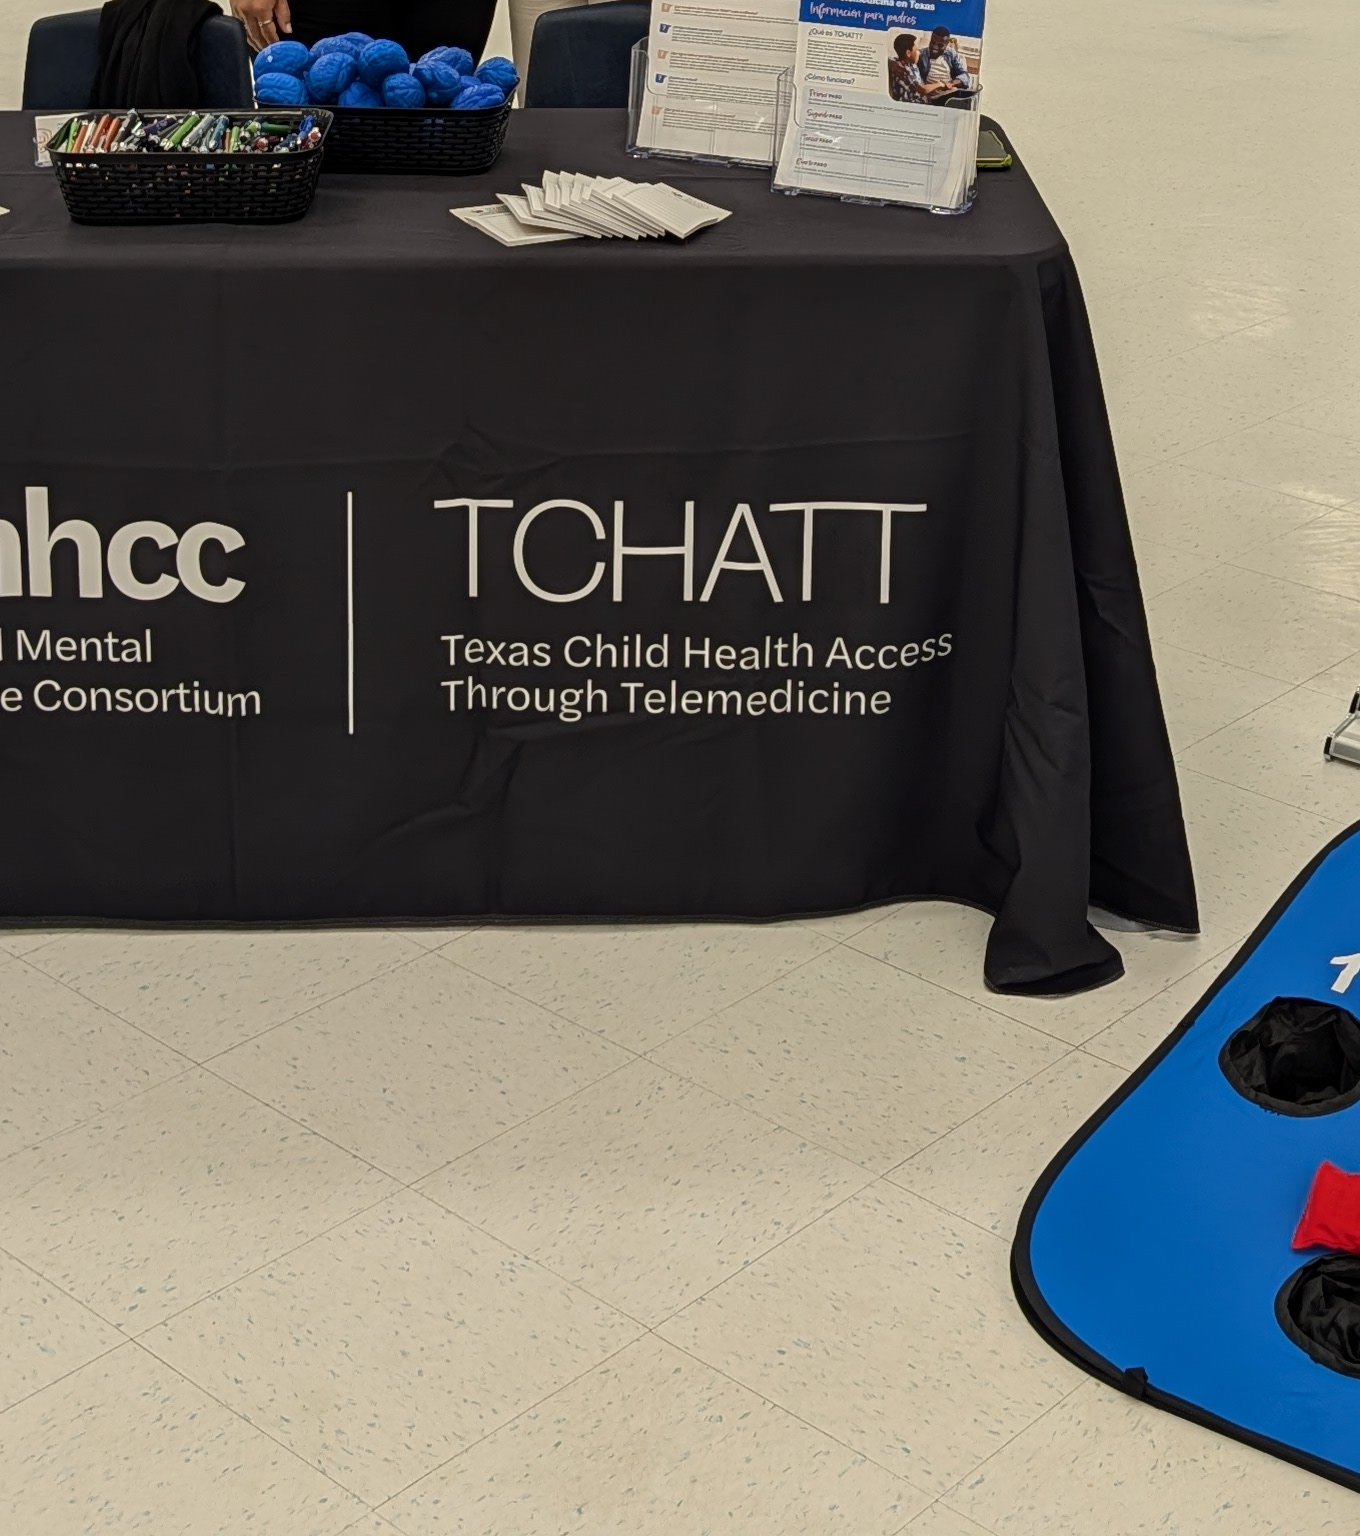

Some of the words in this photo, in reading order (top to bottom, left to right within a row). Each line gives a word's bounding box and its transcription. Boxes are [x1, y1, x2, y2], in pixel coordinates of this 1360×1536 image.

[810, 2, 862, 19] Información
[863, 11, 884, 24] para
[886, 13, 917, 26] padres
[909, 0, 936, 11] Texas
[434, 498, 927, 604] TCHATT
[17, 629, 151, 662] Mental
[441, 635, 550, 666] Texas
[564, 634, 668, 667] Child
[685, 633, 813, 670] Health
[825, 634, 952, 670] Access
[34, 680, 260, 717] Consortium
[441, 676, 607, 722] Through
[621, 679, 891, 716] Telemedicine
